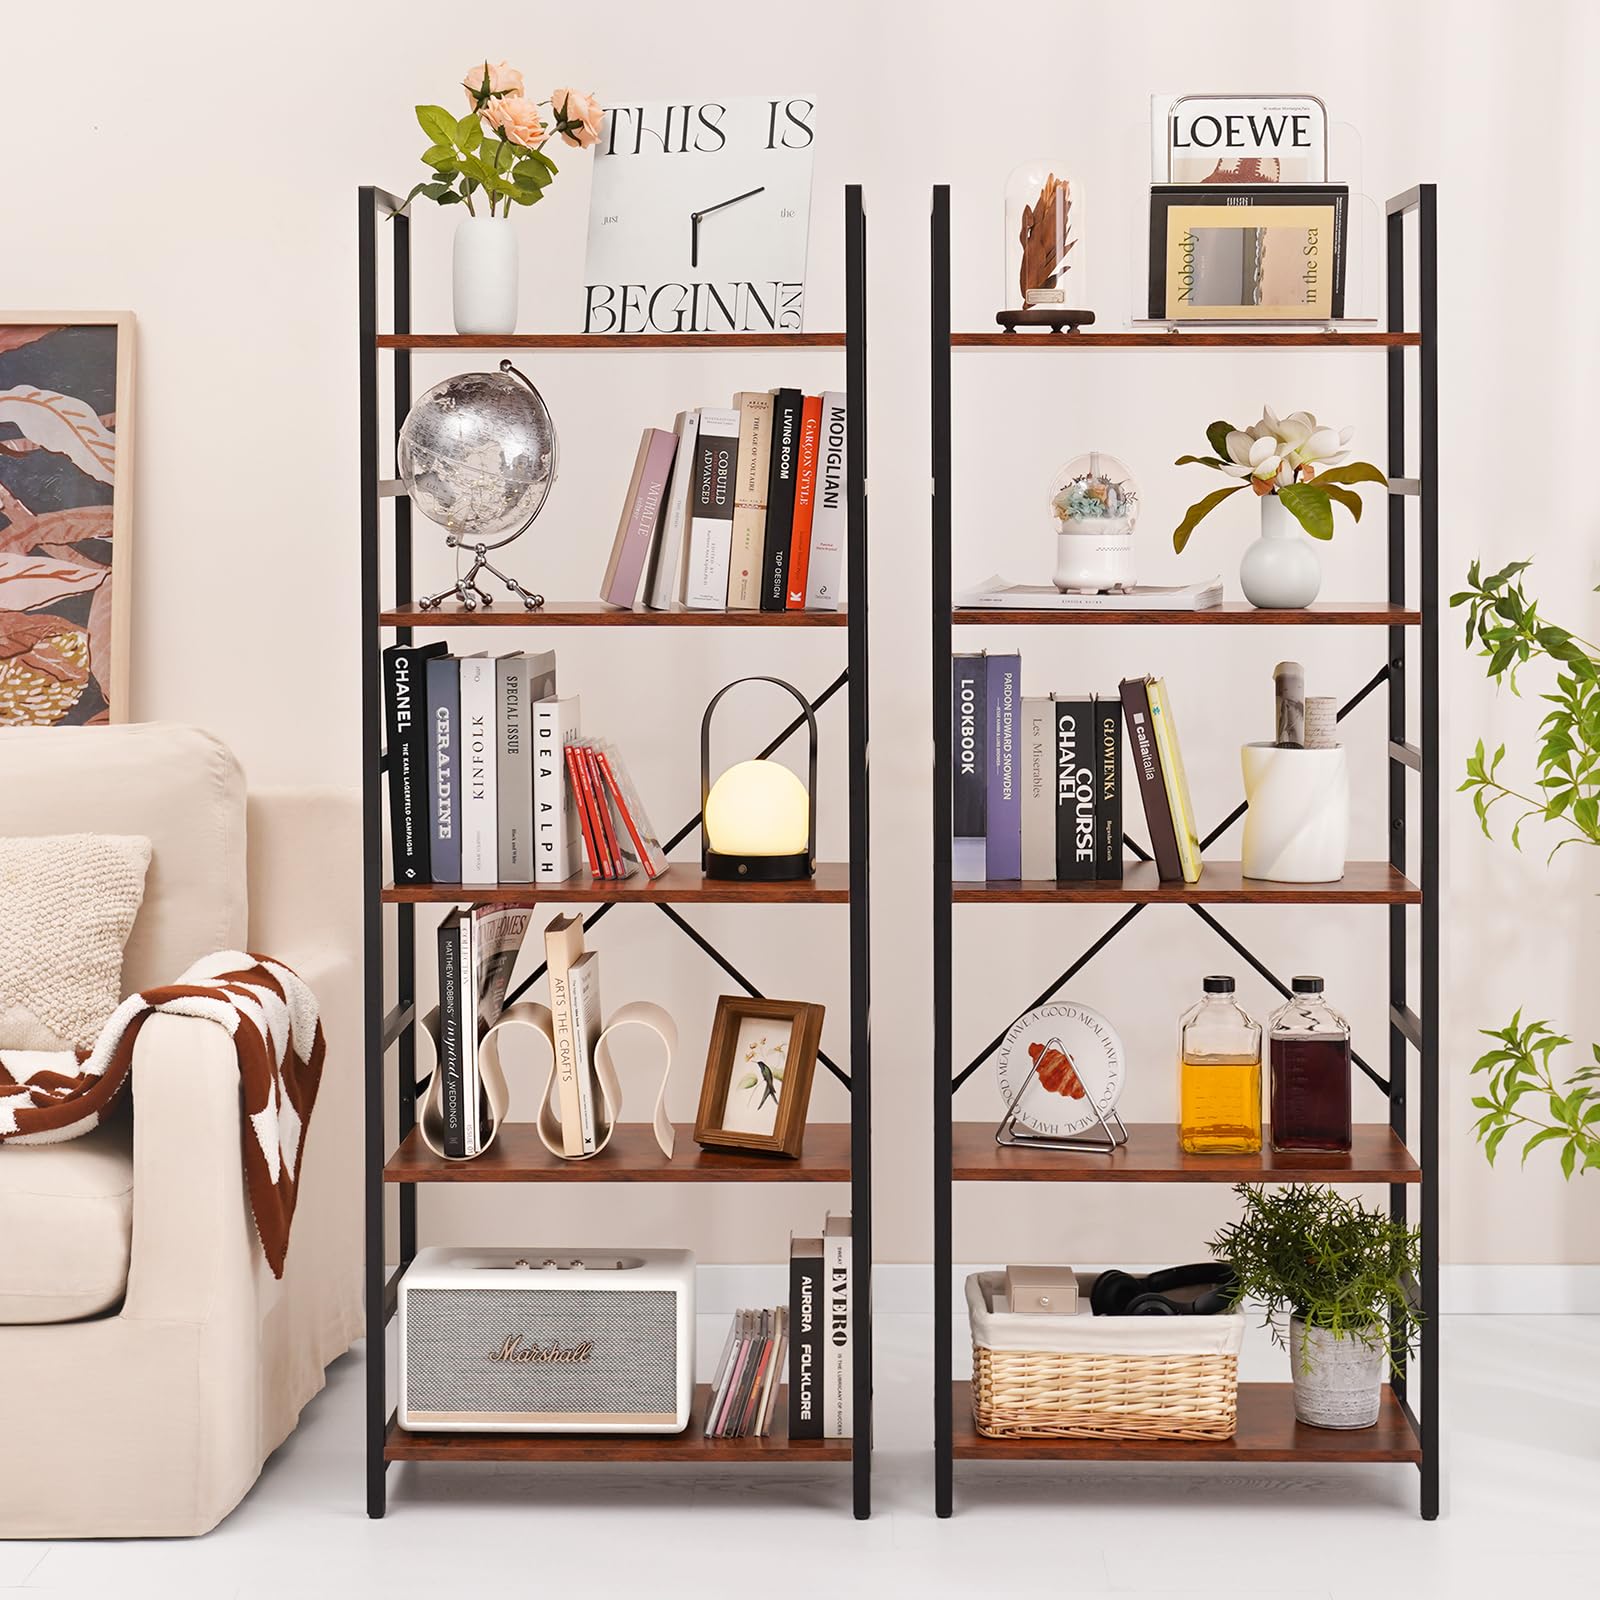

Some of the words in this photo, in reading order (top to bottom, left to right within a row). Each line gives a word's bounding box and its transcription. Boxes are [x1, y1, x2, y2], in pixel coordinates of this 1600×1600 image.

[602, 103, 727, 155] THIS
[763, 99, 815, 150] IS
[1173, 114, 1312, 148] LOEWE
[601, 214, 619, 225] just
[780, 208, 796, 219] the
[1303, 227, 1319, 257] Sea
[1177, 231, 1199, 302] Nobody
[1302, 260, 1318, 287] the
[1302, 289, 1317, 304] in
[751, 432, 760, 446] AGE
[752, 417, 760, 430] THE
[782, 408, 793, 445] LIVING
[800, 418, 817, 467] GARÇON
[823, 407, 846, 509] MODIGLIANI
[701, 449, 713, 505] ADVANCED
[715, 450, 729, 506] COBUILD
[748, 458, 758, 492] VOLTAIRE
[780, 446, 791, 479] ROOM
[798, 469, 813, 506] STYLE
[637, 481, 662, 537] NATHALIE
[775, 550, 783, 567] TOP
[773, 567, 782, 599] DESIGN
[395, 657, 411, 733] CHANEL
[506, 675, 518, 720] SPECIAL
[1003, 672, 1013, 711] PARDON
[507, 724, 519, 755] ISSUE
[539, 713, 551, 778] IDEA
[961, 679, 975, 775] LOOKBOOK
[1003, 712, 1013, 752] EDWARD
[1032, 718, 1043, 738] Les
[472, 715, 484, 800] KINFOLK
[1032, 743, 1043, 799] Miserables
[1059, 715, 1075, 806] CHANEL
[1003, 753, 1012, 800] SNOWDEN
[1076, 768, 1093, 862] COURSE
[405, 817, 413, 856] CAMPAIGNS
[540, 802, 553, 873] ALPH
[445, 941, 453, 979] MATTHEW
[555, 978, 566, 1006] ARTS
[557, 1011, 568, 1034] THE
[1031, 1013, 1040, 1022] A
[1041, 1006, 1077, 1018] GOOD
[1078, 1012, 1104, 1035] MEAL
[1007, 1018, 1031, 1044] HAVE
[560, 1039, 572, 1082] CRAFTS
[999, 1047, 1013, 1076] MEAL
[1101, 1037, 1118, 1068] HAVE
[1108, 1071, 1117, 1079] A
[447, 1081, 458, 1129] WEDDINGS
[1031, 1118, 1059, 1134] HAVE
[1064, 1115, 1094, 1133] MEAL
[801, 1276, 812, 1333] AURORA
[832, 1268, 848, 1346] EVERO
[489, 1333, 594, 1364] Marshall
[800, 1344, 812, 1421] FOLKLORE
